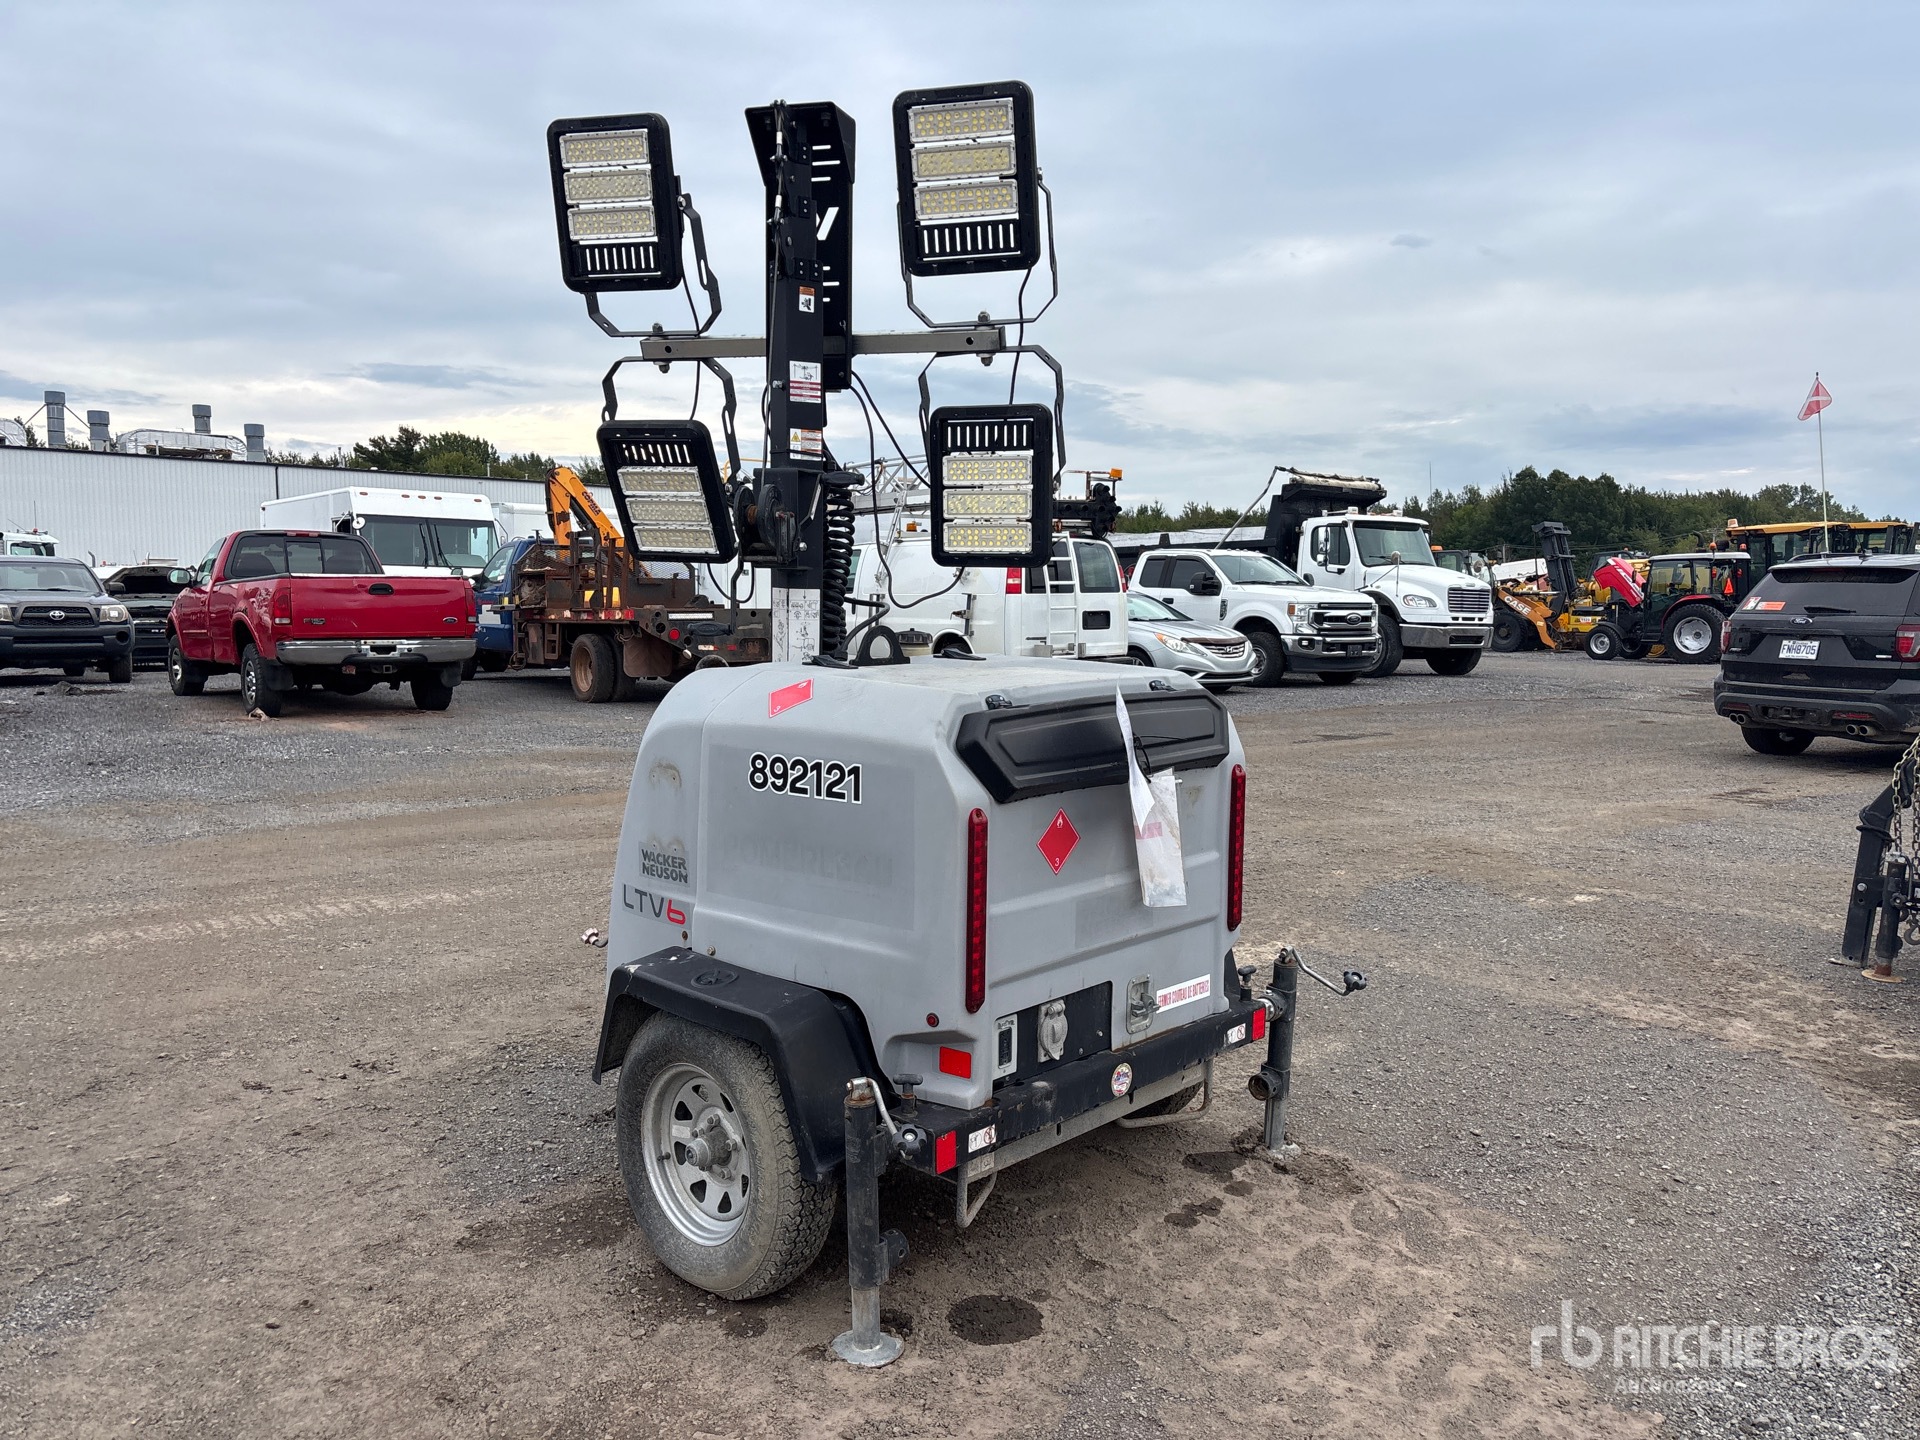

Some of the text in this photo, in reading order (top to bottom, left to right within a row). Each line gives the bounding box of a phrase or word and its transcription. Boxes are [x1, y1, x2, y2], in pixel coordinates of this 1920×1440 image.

[1504, 595, 1532, 616] CASE
[1781, 644, 1817, 655] FNH8705
[748, 751, 862, 804] 892121
[641, 848, 687, 871] WACKER
[1054, 857, 1060, 867] 3
[642, 861, 689, 884] NEUSON
[623, 883, 687, 926] LTV6
